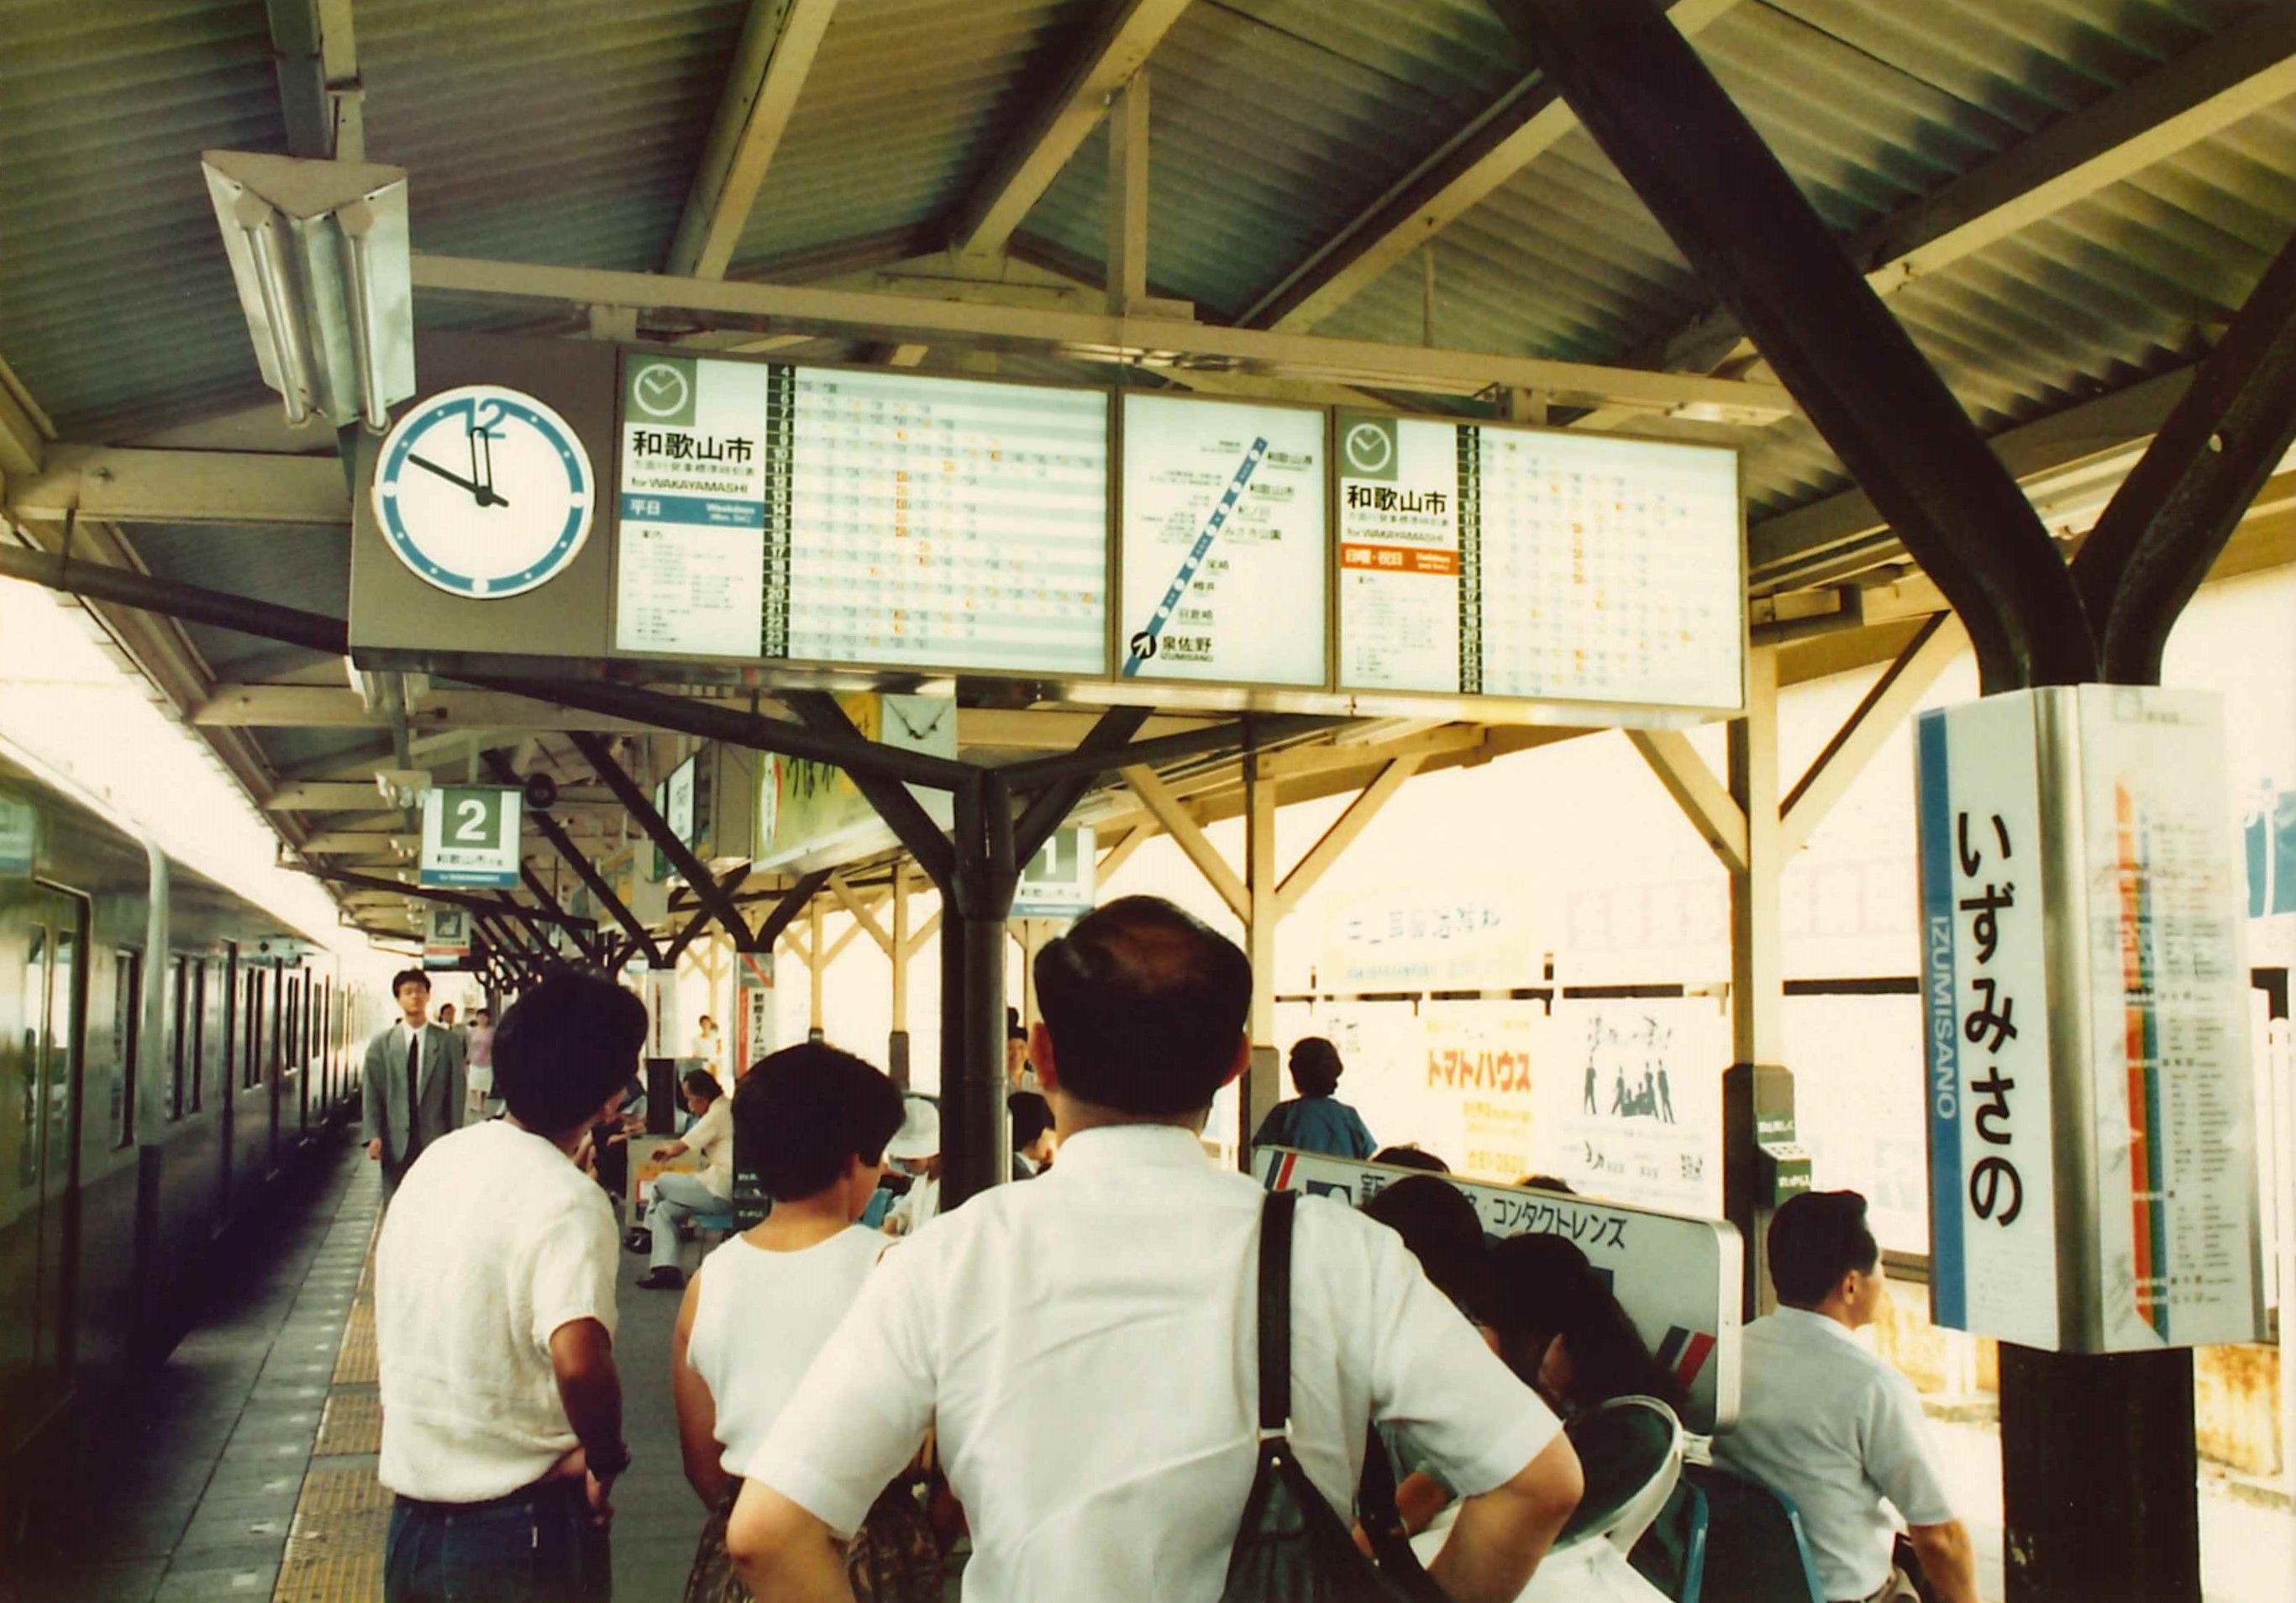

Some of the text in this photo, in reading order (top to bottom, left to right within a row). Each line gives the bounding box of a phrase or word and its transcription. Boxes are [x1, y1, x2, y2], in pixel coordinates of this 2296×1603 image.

[460, 397, 506, 439] 12
[633, 430, 754, 463] 和歌山市
[630, 498, 660, 517] 平日
[1348, 485, 1447, 515] 和歌山市
[1161, 636, 1212, 654] 泉佐野
[455, 799, 486, 841] 2
[1042, 835, 1057, 875] 1
[1932, 916, 1957, 1120] IZUMISANO
[1959, 812, 2023, 1227] いずみさの
[1428, 1049, 1532, 1092] トマトハウス
[1494, 1198, 1626, 1249] コンタクトレンズ
